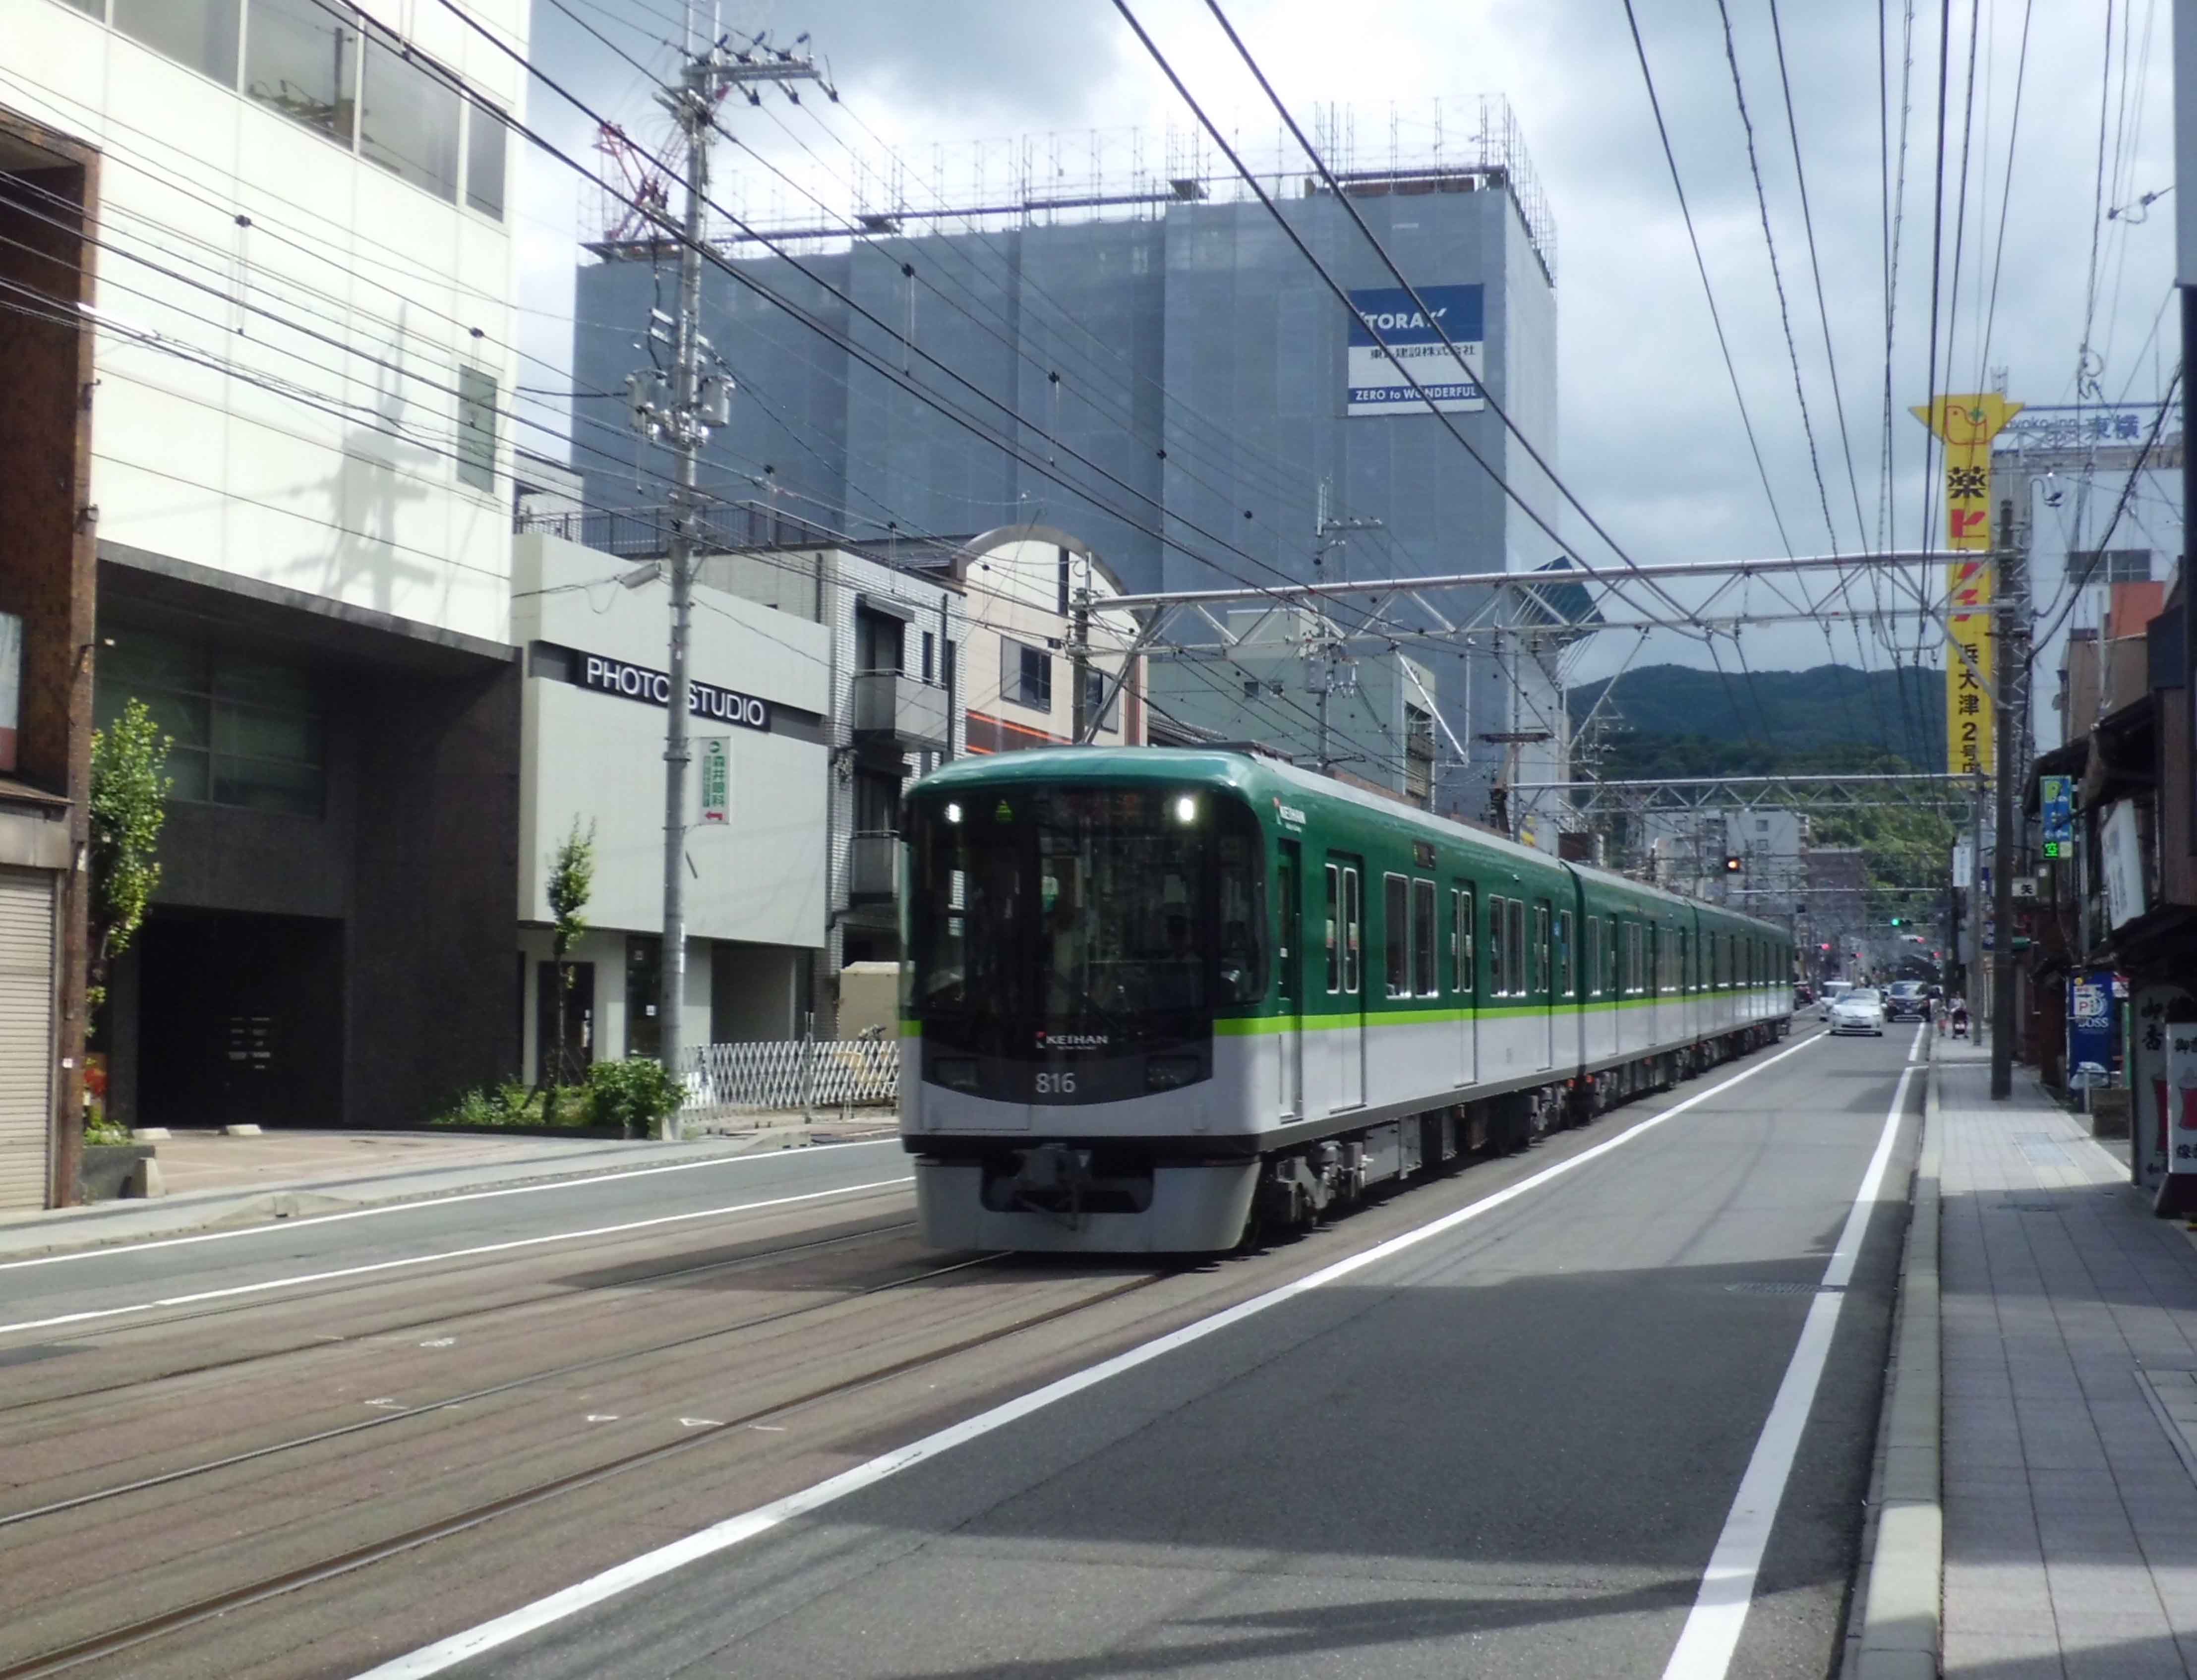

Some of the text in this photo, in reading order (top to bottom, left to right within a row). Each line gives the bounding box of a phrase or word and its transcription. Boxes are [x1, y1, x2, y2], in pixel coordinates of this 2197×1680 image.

[1370, 345, 1476, 360] 東建設株式会社
[1356, 390, 1385, 401] ZERO
[1390, 390, 1401, 399] to
[587, 657, 764, 726] PHOTO STUDIO
[1046, 1035, 1109, 1044] KEIHAN
[1036, 1072, 1076, 1093] 816
